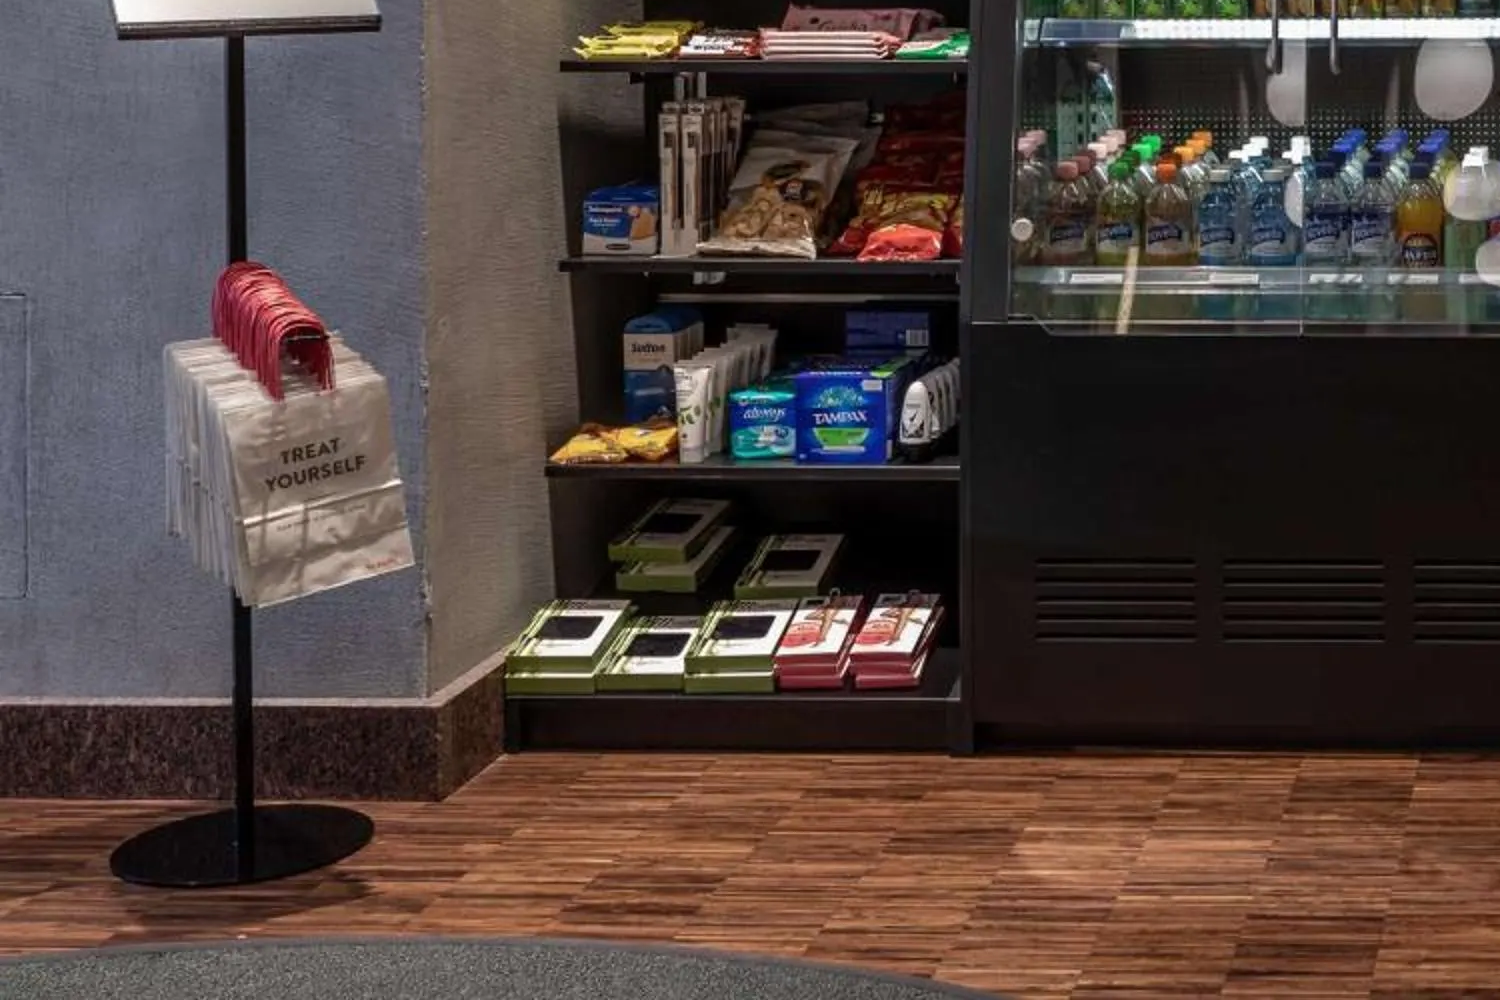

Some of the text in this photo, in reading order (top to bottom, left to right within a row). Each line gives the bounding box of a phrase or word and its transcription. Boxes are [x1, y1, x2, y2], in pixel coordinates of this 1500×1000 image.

[743, 407, 787, 423] always
[812, 410, 868, 425] TAMPAX
[280, 437, 341, 465] TREAT
[265, 455, 366, 492] YOURSELF
